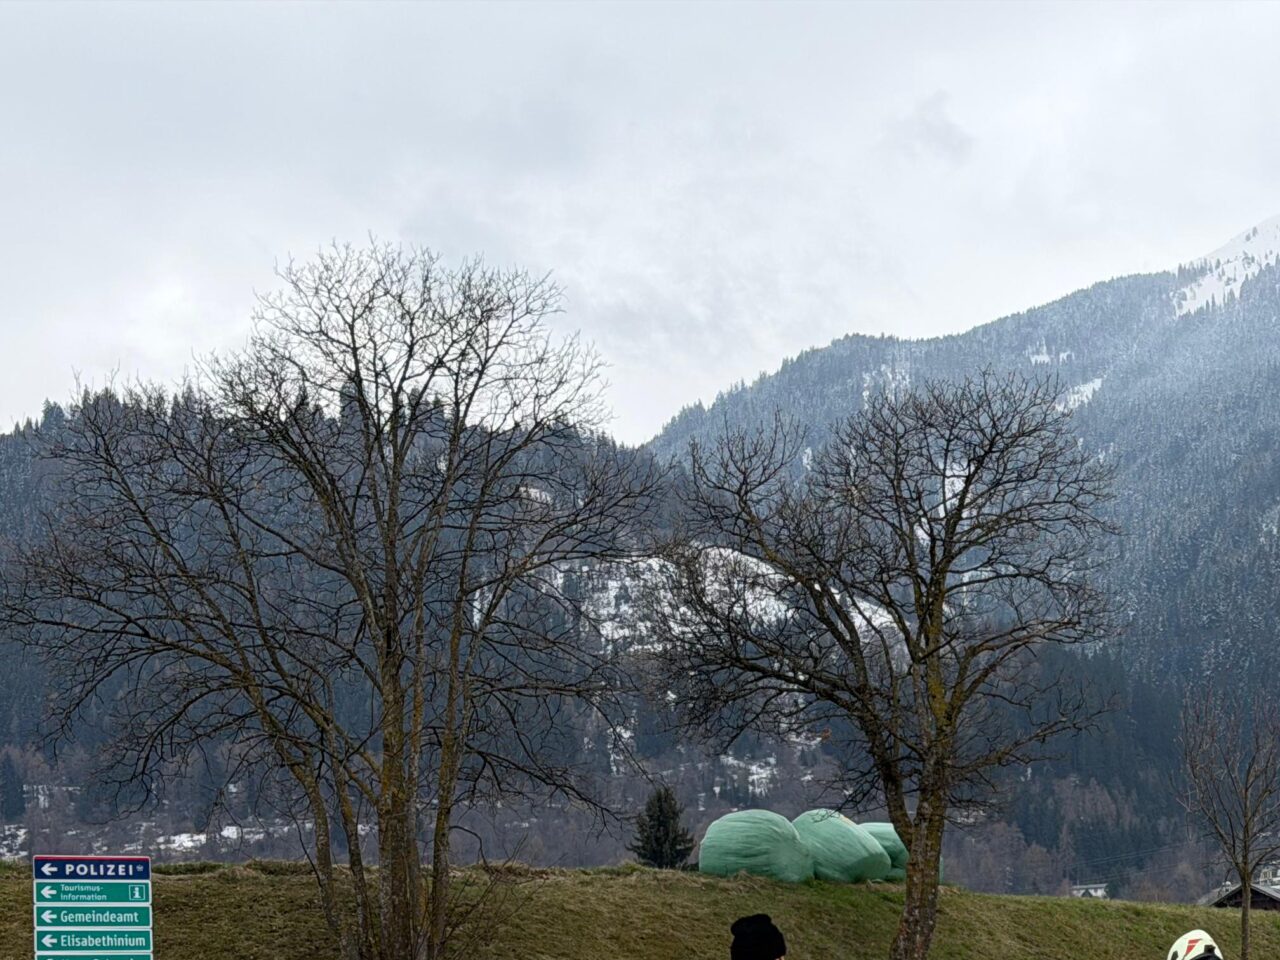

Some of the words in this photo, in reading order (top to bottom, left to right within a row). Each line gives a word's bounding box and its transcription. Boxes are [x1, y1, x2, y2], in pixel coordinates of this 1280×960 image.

[65, 864, 133, 876] POLIZEI
[60, 910, 139, 923] Gemeindeamt
[60, 934, 146, 947] Elisabethinium
